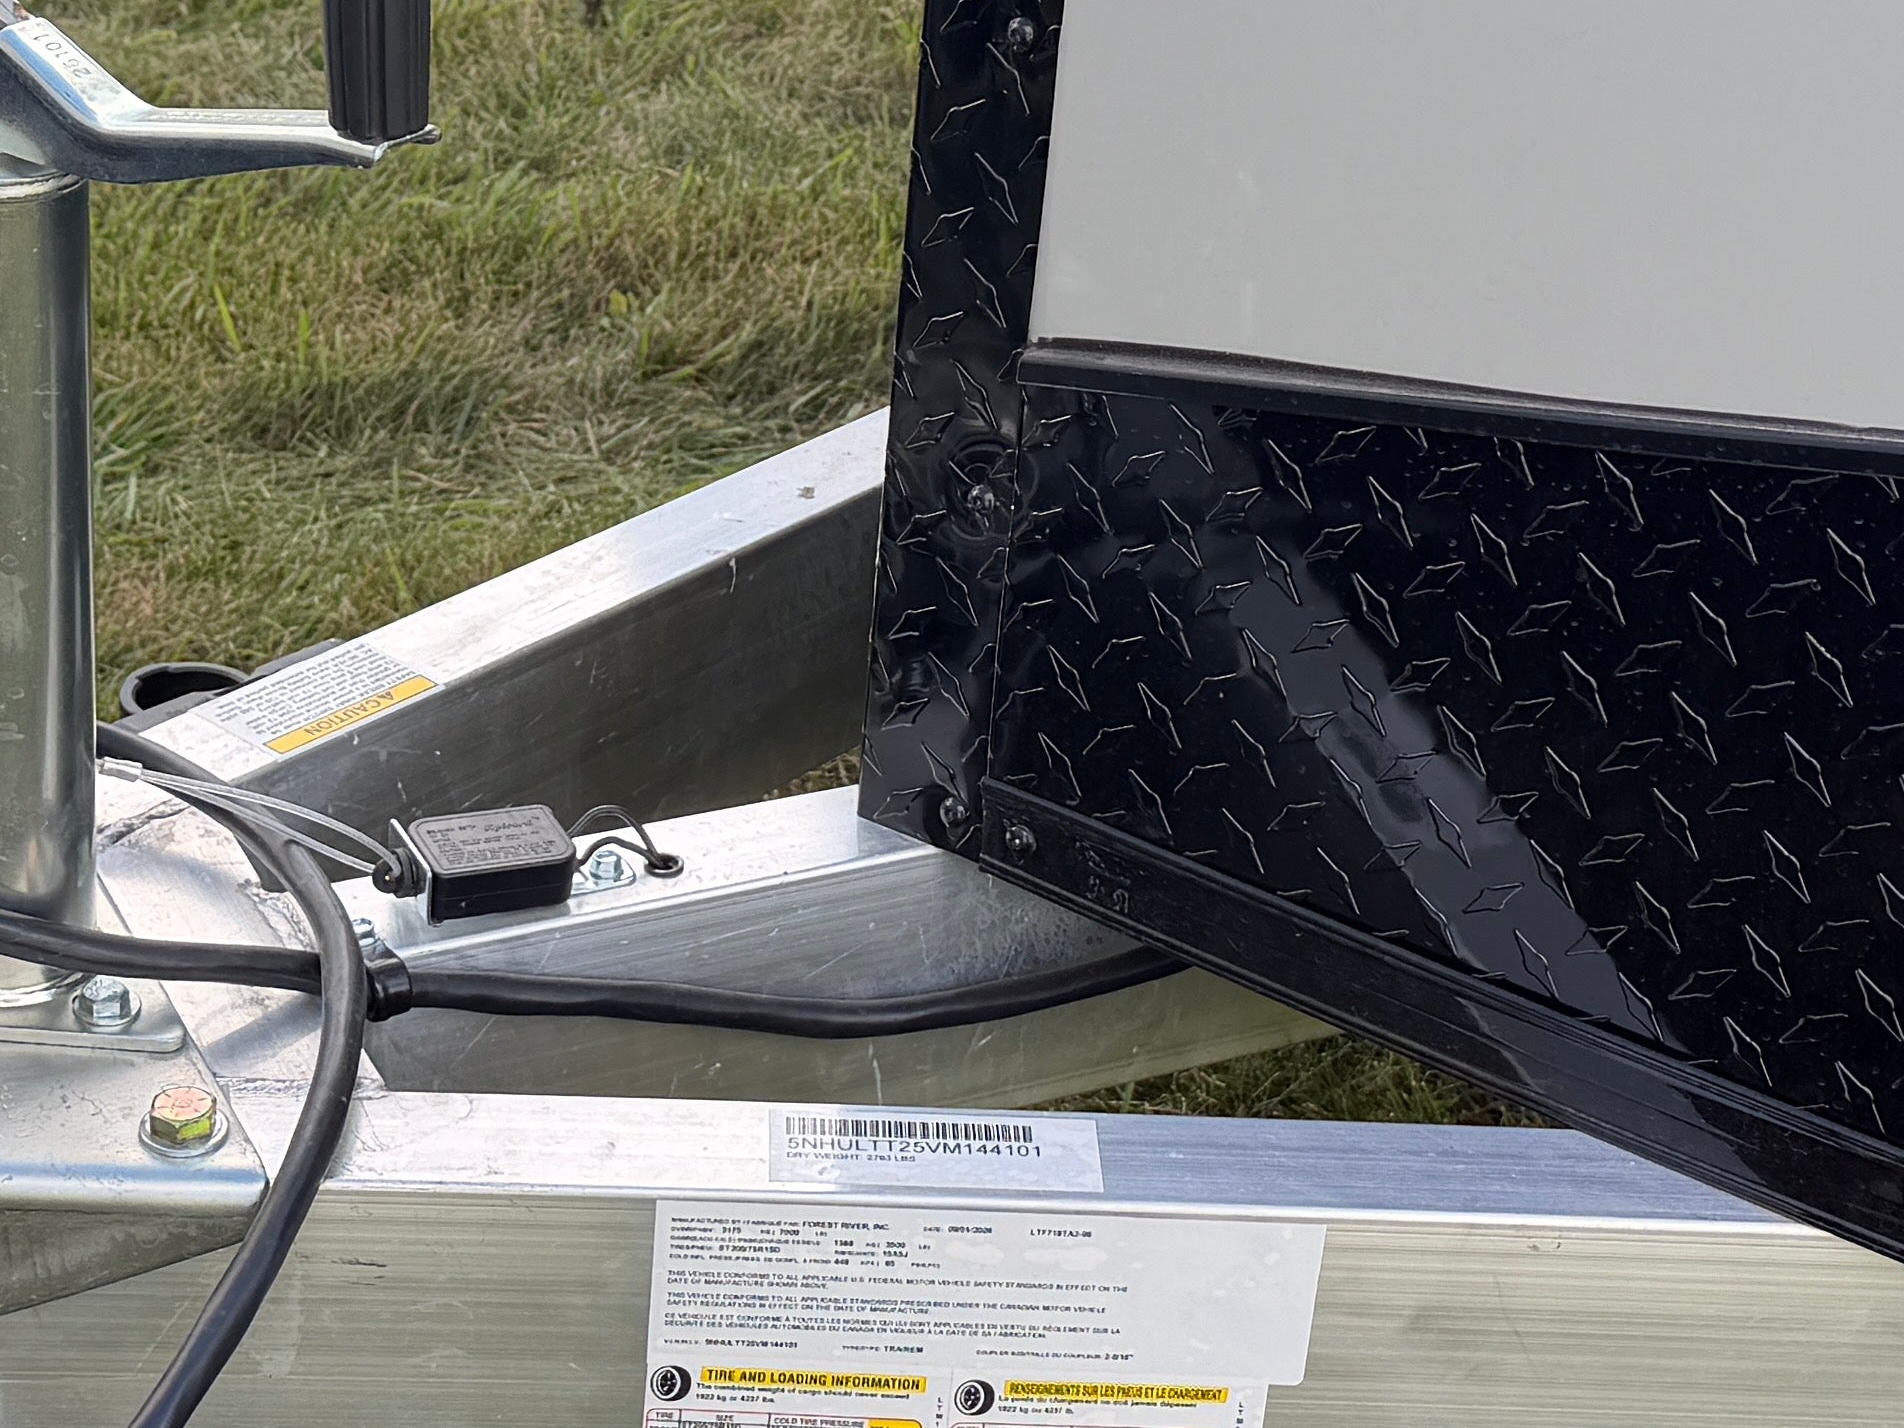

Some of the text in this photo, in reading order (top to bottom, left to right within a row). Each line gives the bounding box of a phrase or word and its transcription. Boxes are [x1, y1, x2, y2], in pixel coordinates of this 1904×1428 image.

[304, 699, 381, 736] CAUTION
[787, 1136, 1041, 1157] 5NHULTT25VM144101
[802, 1274, 848, 1282] APPLICABLE
[800, 1296, 847, 1304] APPLICABLE
[706, 1368, 920, 1390] TIRE AND LOADING INFORMATION
[1008, 1381, 1222, 1401] RENSEIGNEMENTS SUR LES PNEUS ET LE CHARGEMENT
[774, 1416, 796, 1424] COLD
[820, 1418, 864, 1427] PRESSURE
